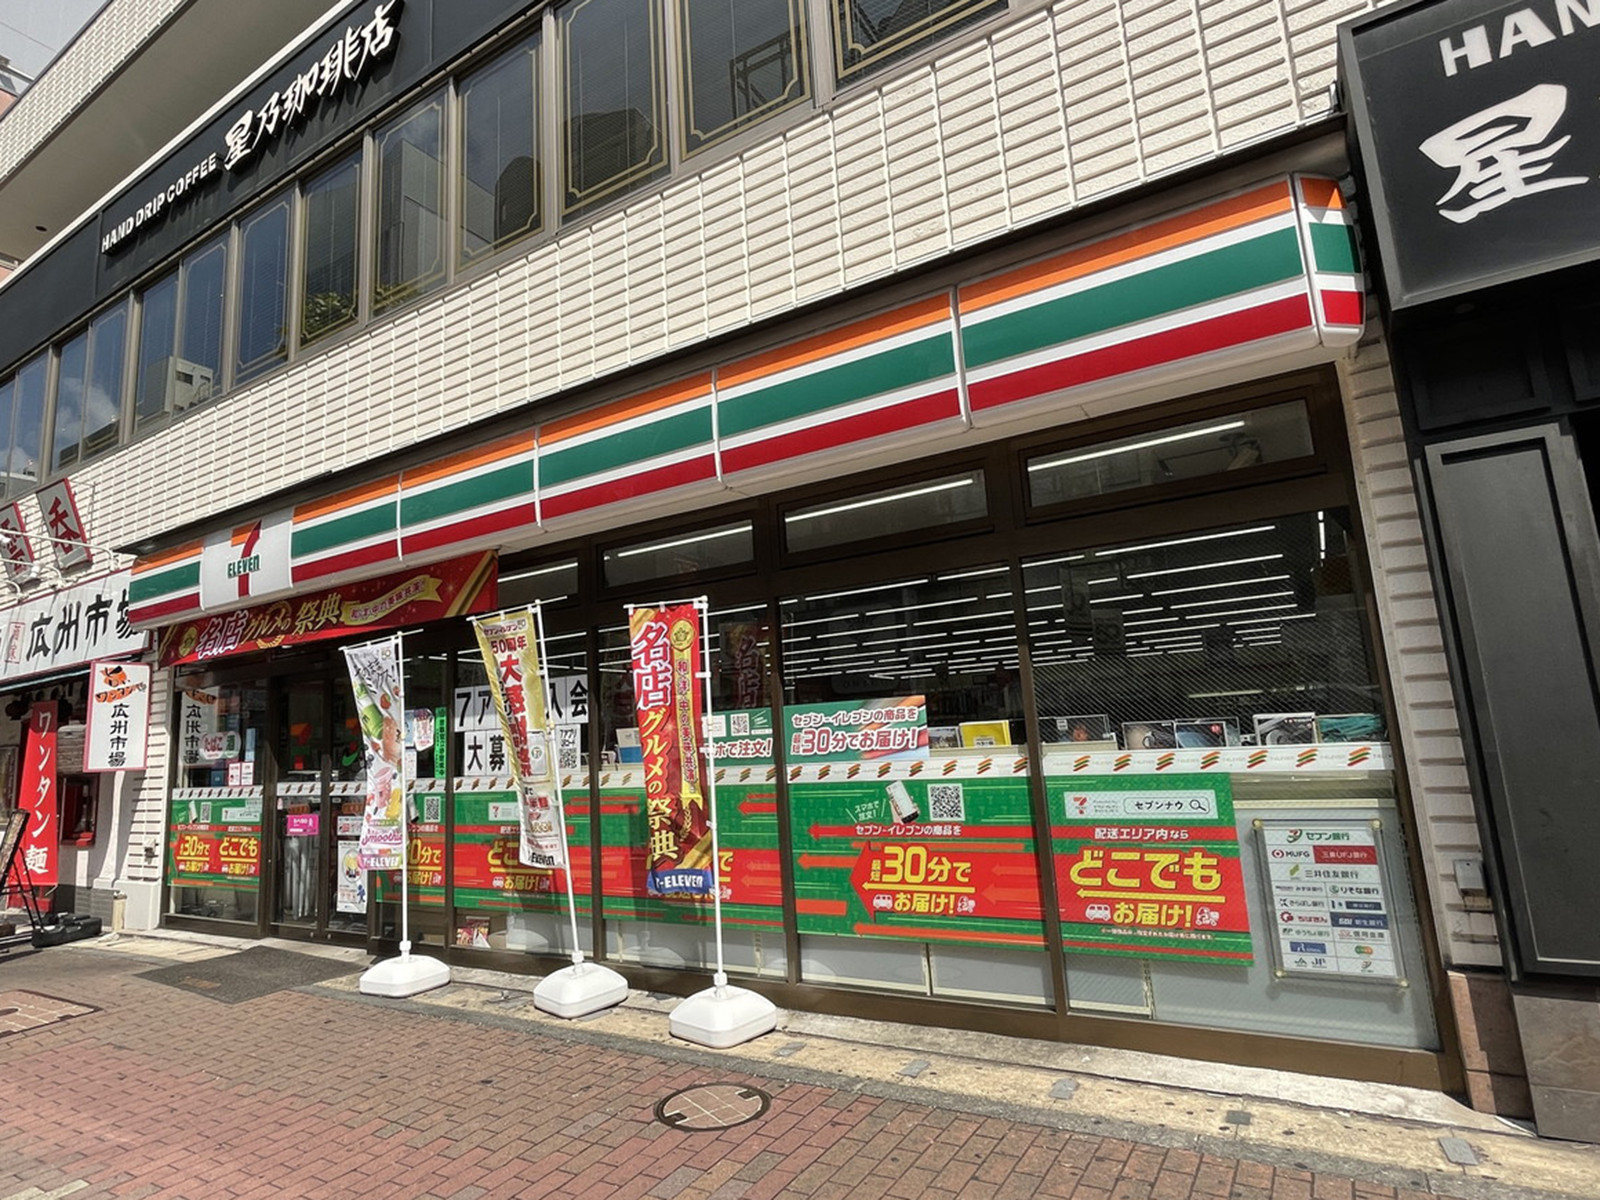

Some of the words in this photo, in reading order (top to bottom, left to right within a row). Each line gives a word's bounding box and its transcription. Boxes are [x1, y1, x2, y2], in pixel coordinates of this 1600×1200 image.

[224, 1, 396, 170] 星乃珈琲店
[1418, 84, 1590, 224] 星
[101, 217, 134, 253] HAND
[135, 192, 165, 227] DRIP
[167, 153, 216, 203] COFFEE
[108, 703, 129, 767] 広州市場
[631, 621, 679, 861] 名店グルメの祭典
[1135, 800, 1184, 811] セブンナウ
[219, 836, 258, 857] どこでも
[1094, 827, 1189, 840] 配送エリア内なら
[1305, 831, 1350, 841] セブン銀行
[1069, 849, 1222, 891] どこでも
[1305, 869, 1359, 879] 三井住友銀行
[1340, 886, 1379, 895] りそな銀行
[1113, 901, 1193, 928] お届け!
